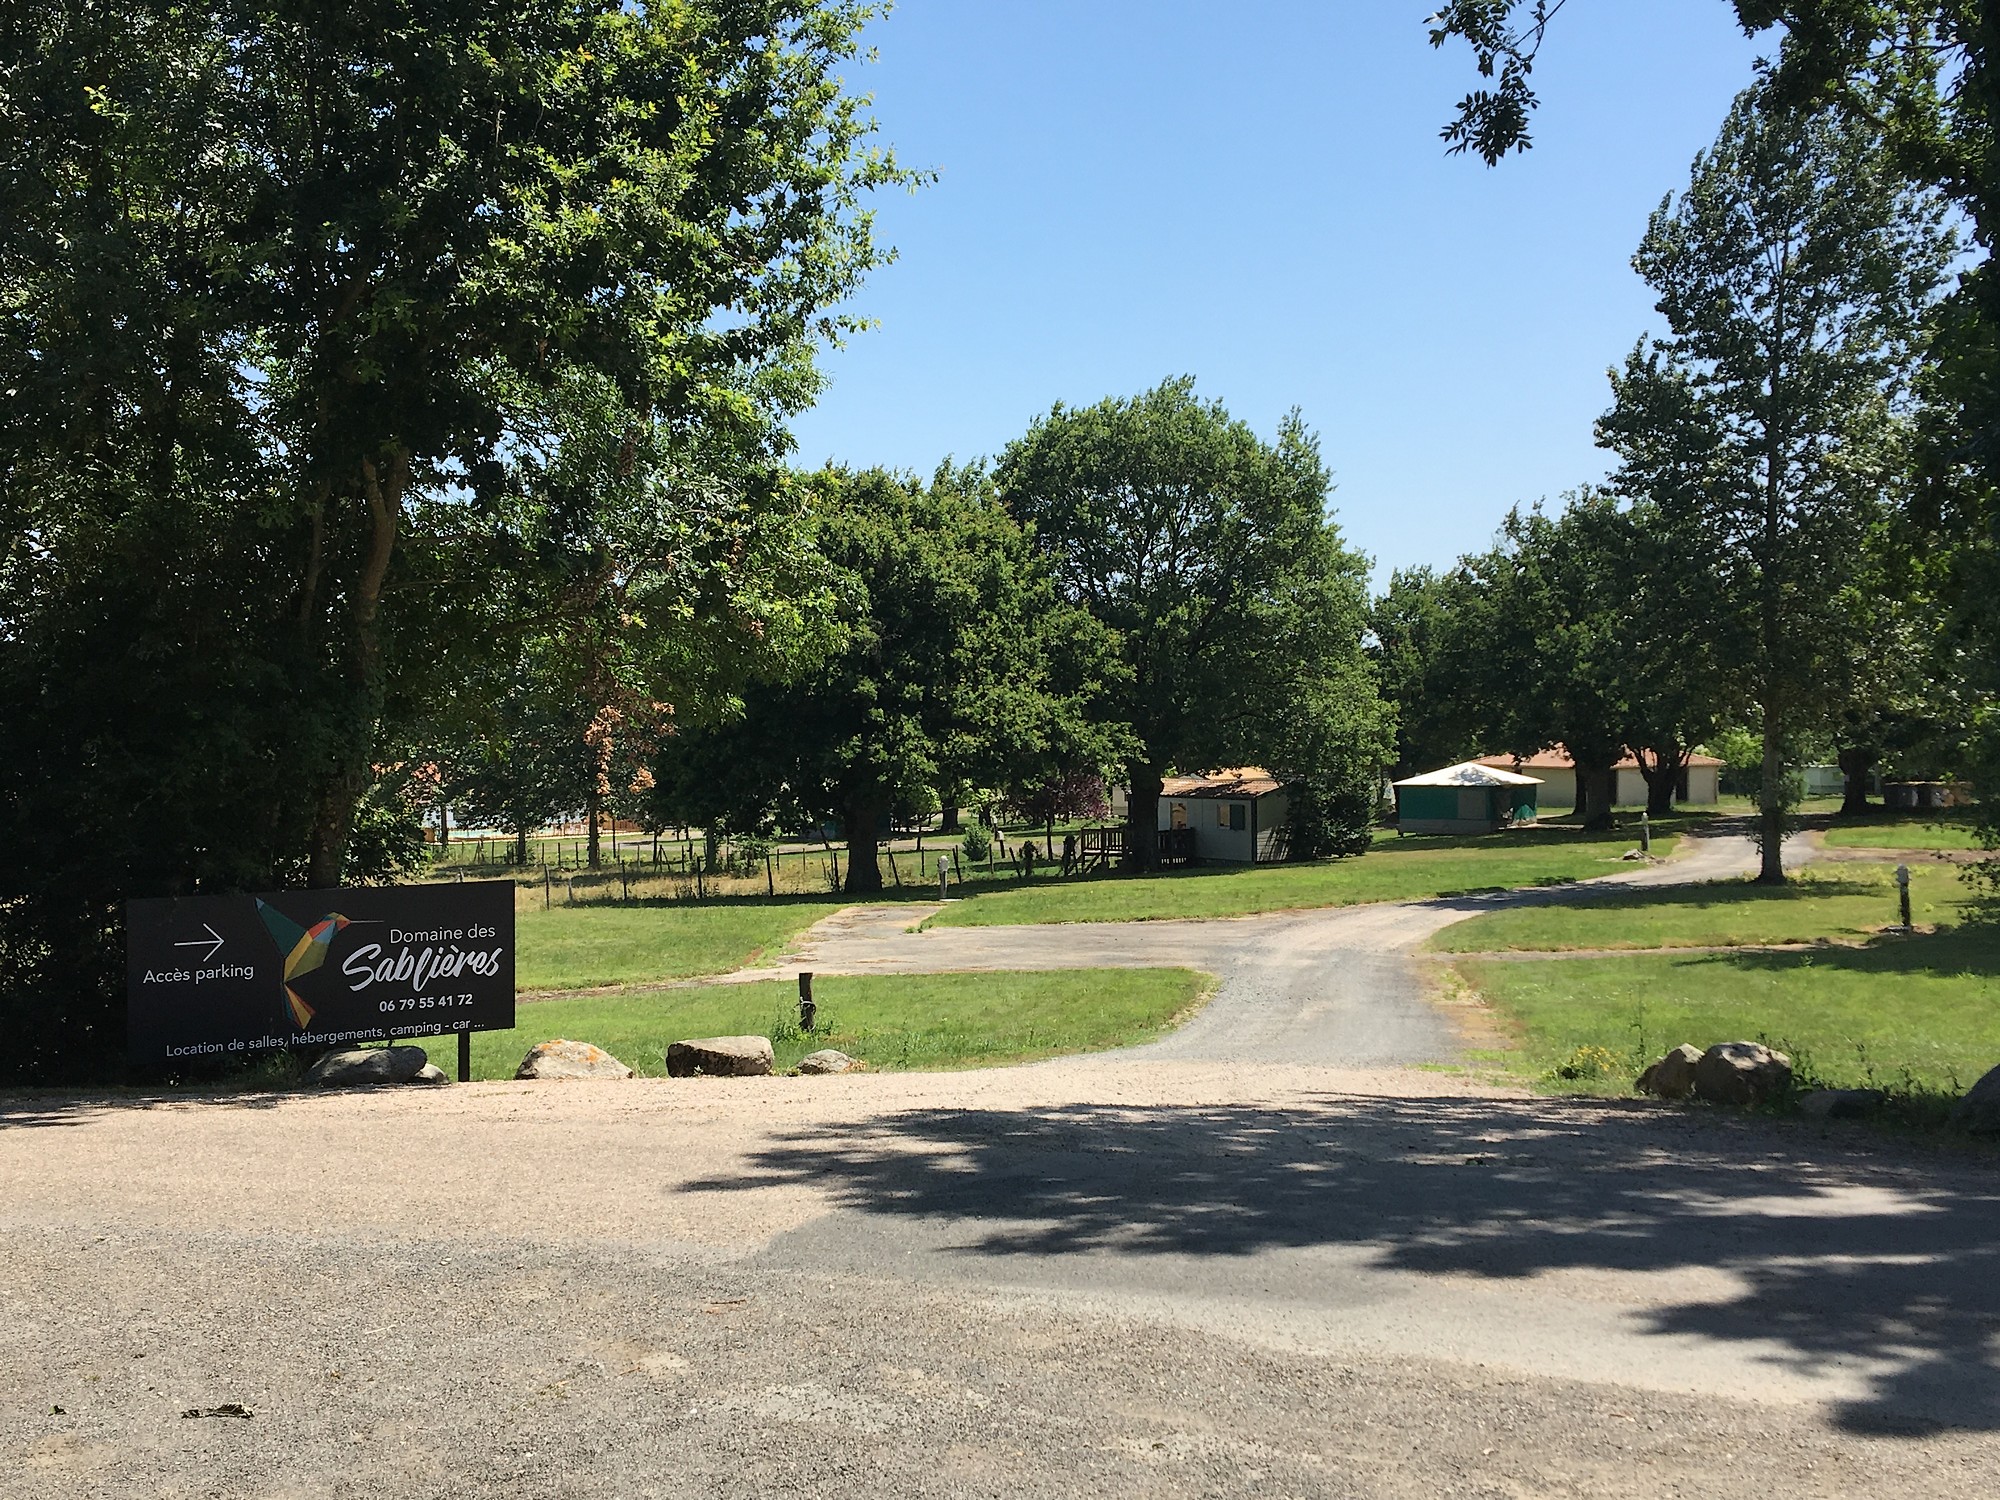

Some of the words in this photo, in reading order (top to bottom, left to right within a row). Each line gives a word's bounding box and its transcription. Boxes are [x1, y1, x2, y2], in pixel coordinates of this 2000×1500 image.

[390, 926, 463, 944] Domaine
[467, 923, 496, 939] des
[143, 967, 191, 984] Accès
[195, 963, 254, 985] parking
[342, 943, 503, 992] Sablières
[379, 1000, 395, 1012] 06
[400, 999, 415, 1011] 79
[419, 997, 434, 1009] 55
[438, 995, 453, 1007] 41
[457, 993, 473, 1005] 72
[166, 1041, 224, 1057] Location
[228, 1038, 245, 1050] de
[291, 1027, 386, 1045] hébergements,
[390, 1021, 441, 1037] camping
[452, 1019, 470, 1030] car
